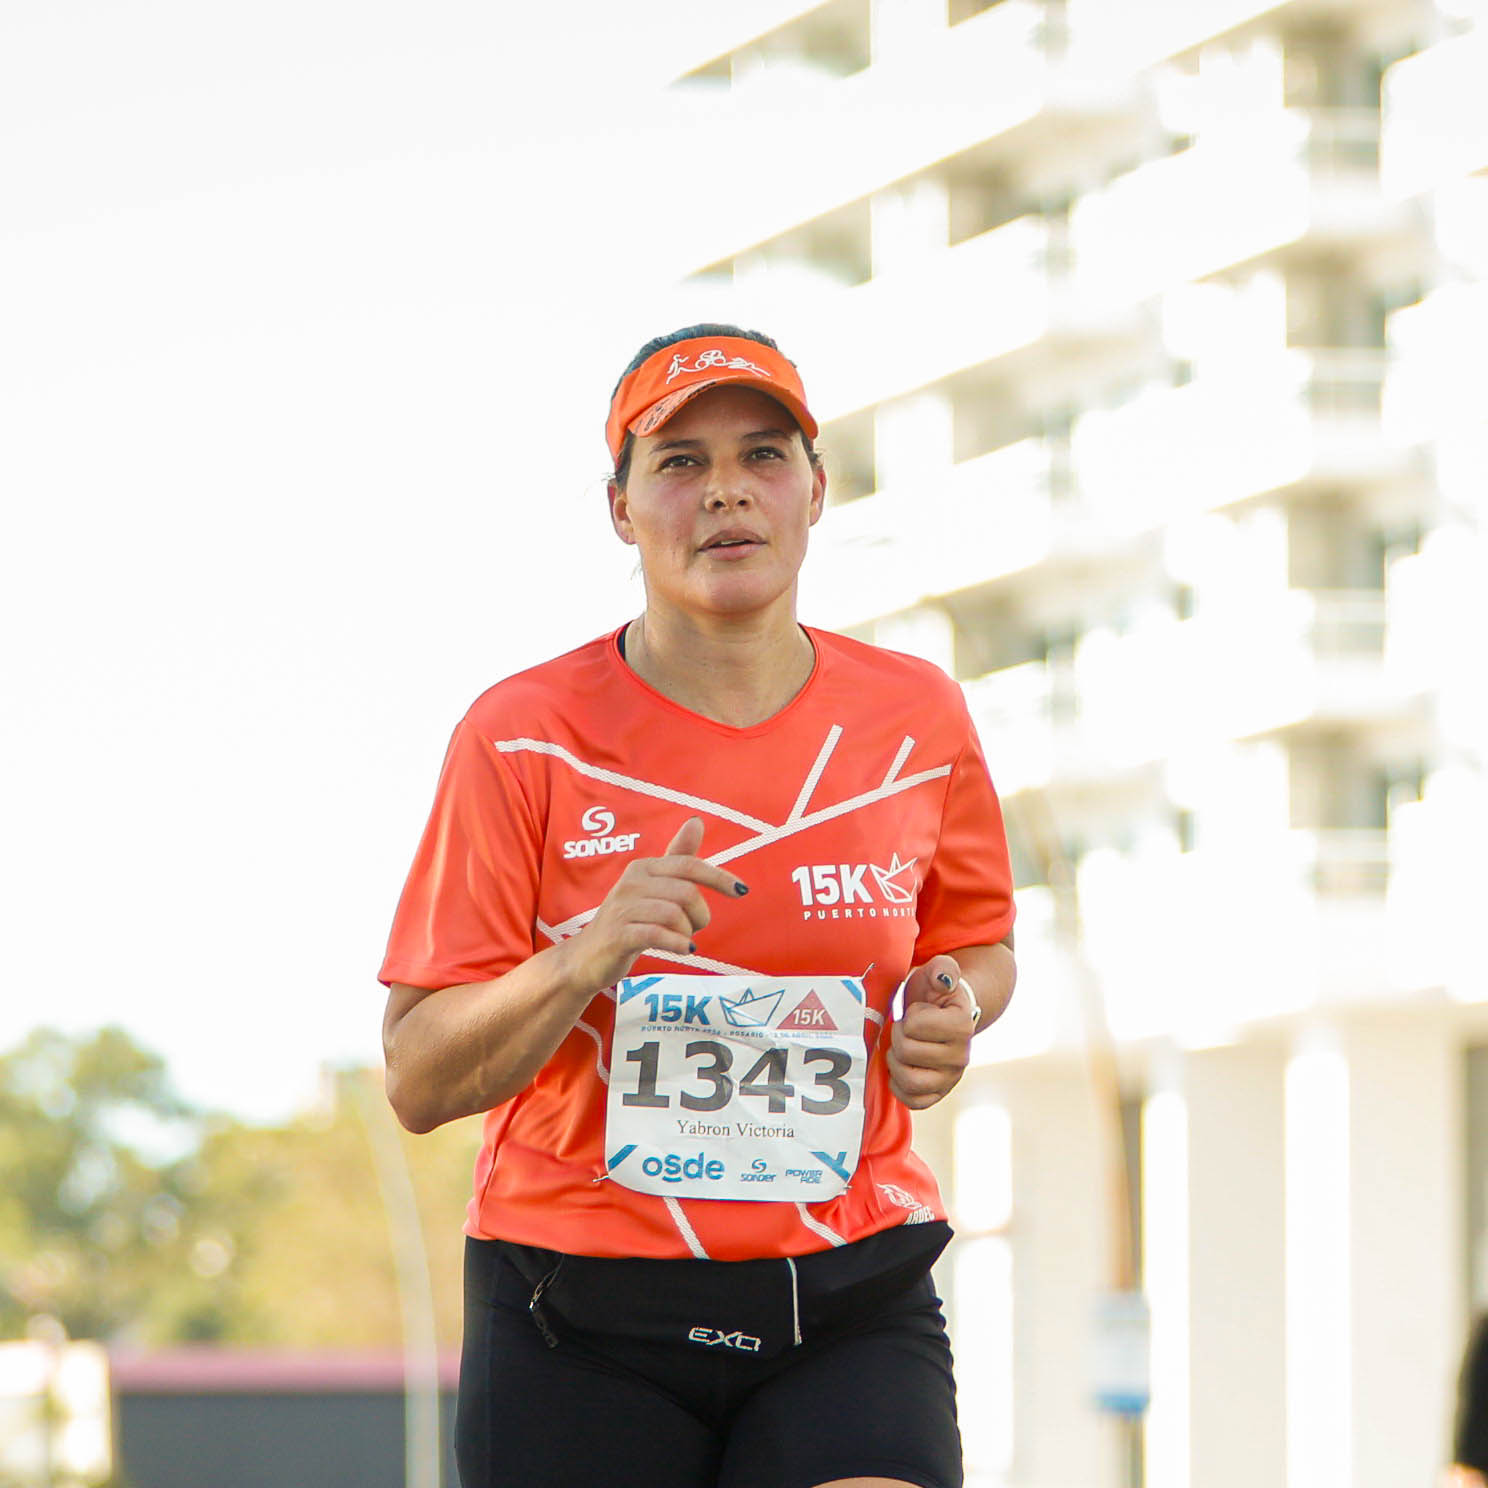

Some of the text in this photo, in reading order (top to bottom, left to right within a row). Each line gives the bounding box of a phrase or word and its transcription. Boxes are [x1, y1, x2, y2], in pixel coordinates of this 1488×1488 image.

[791, 864, 874, 906] 15K
[803, 908, 877, 921] PUERTO
[644, 993, 713, 1025] 15K
[793, 1009, 827, 1026] 15K
[622, 1041, 852, 1116] 1343
[677, 1119, 795, 1138] Yabron Victoria
[642, 1152, 725, 1181] osde
